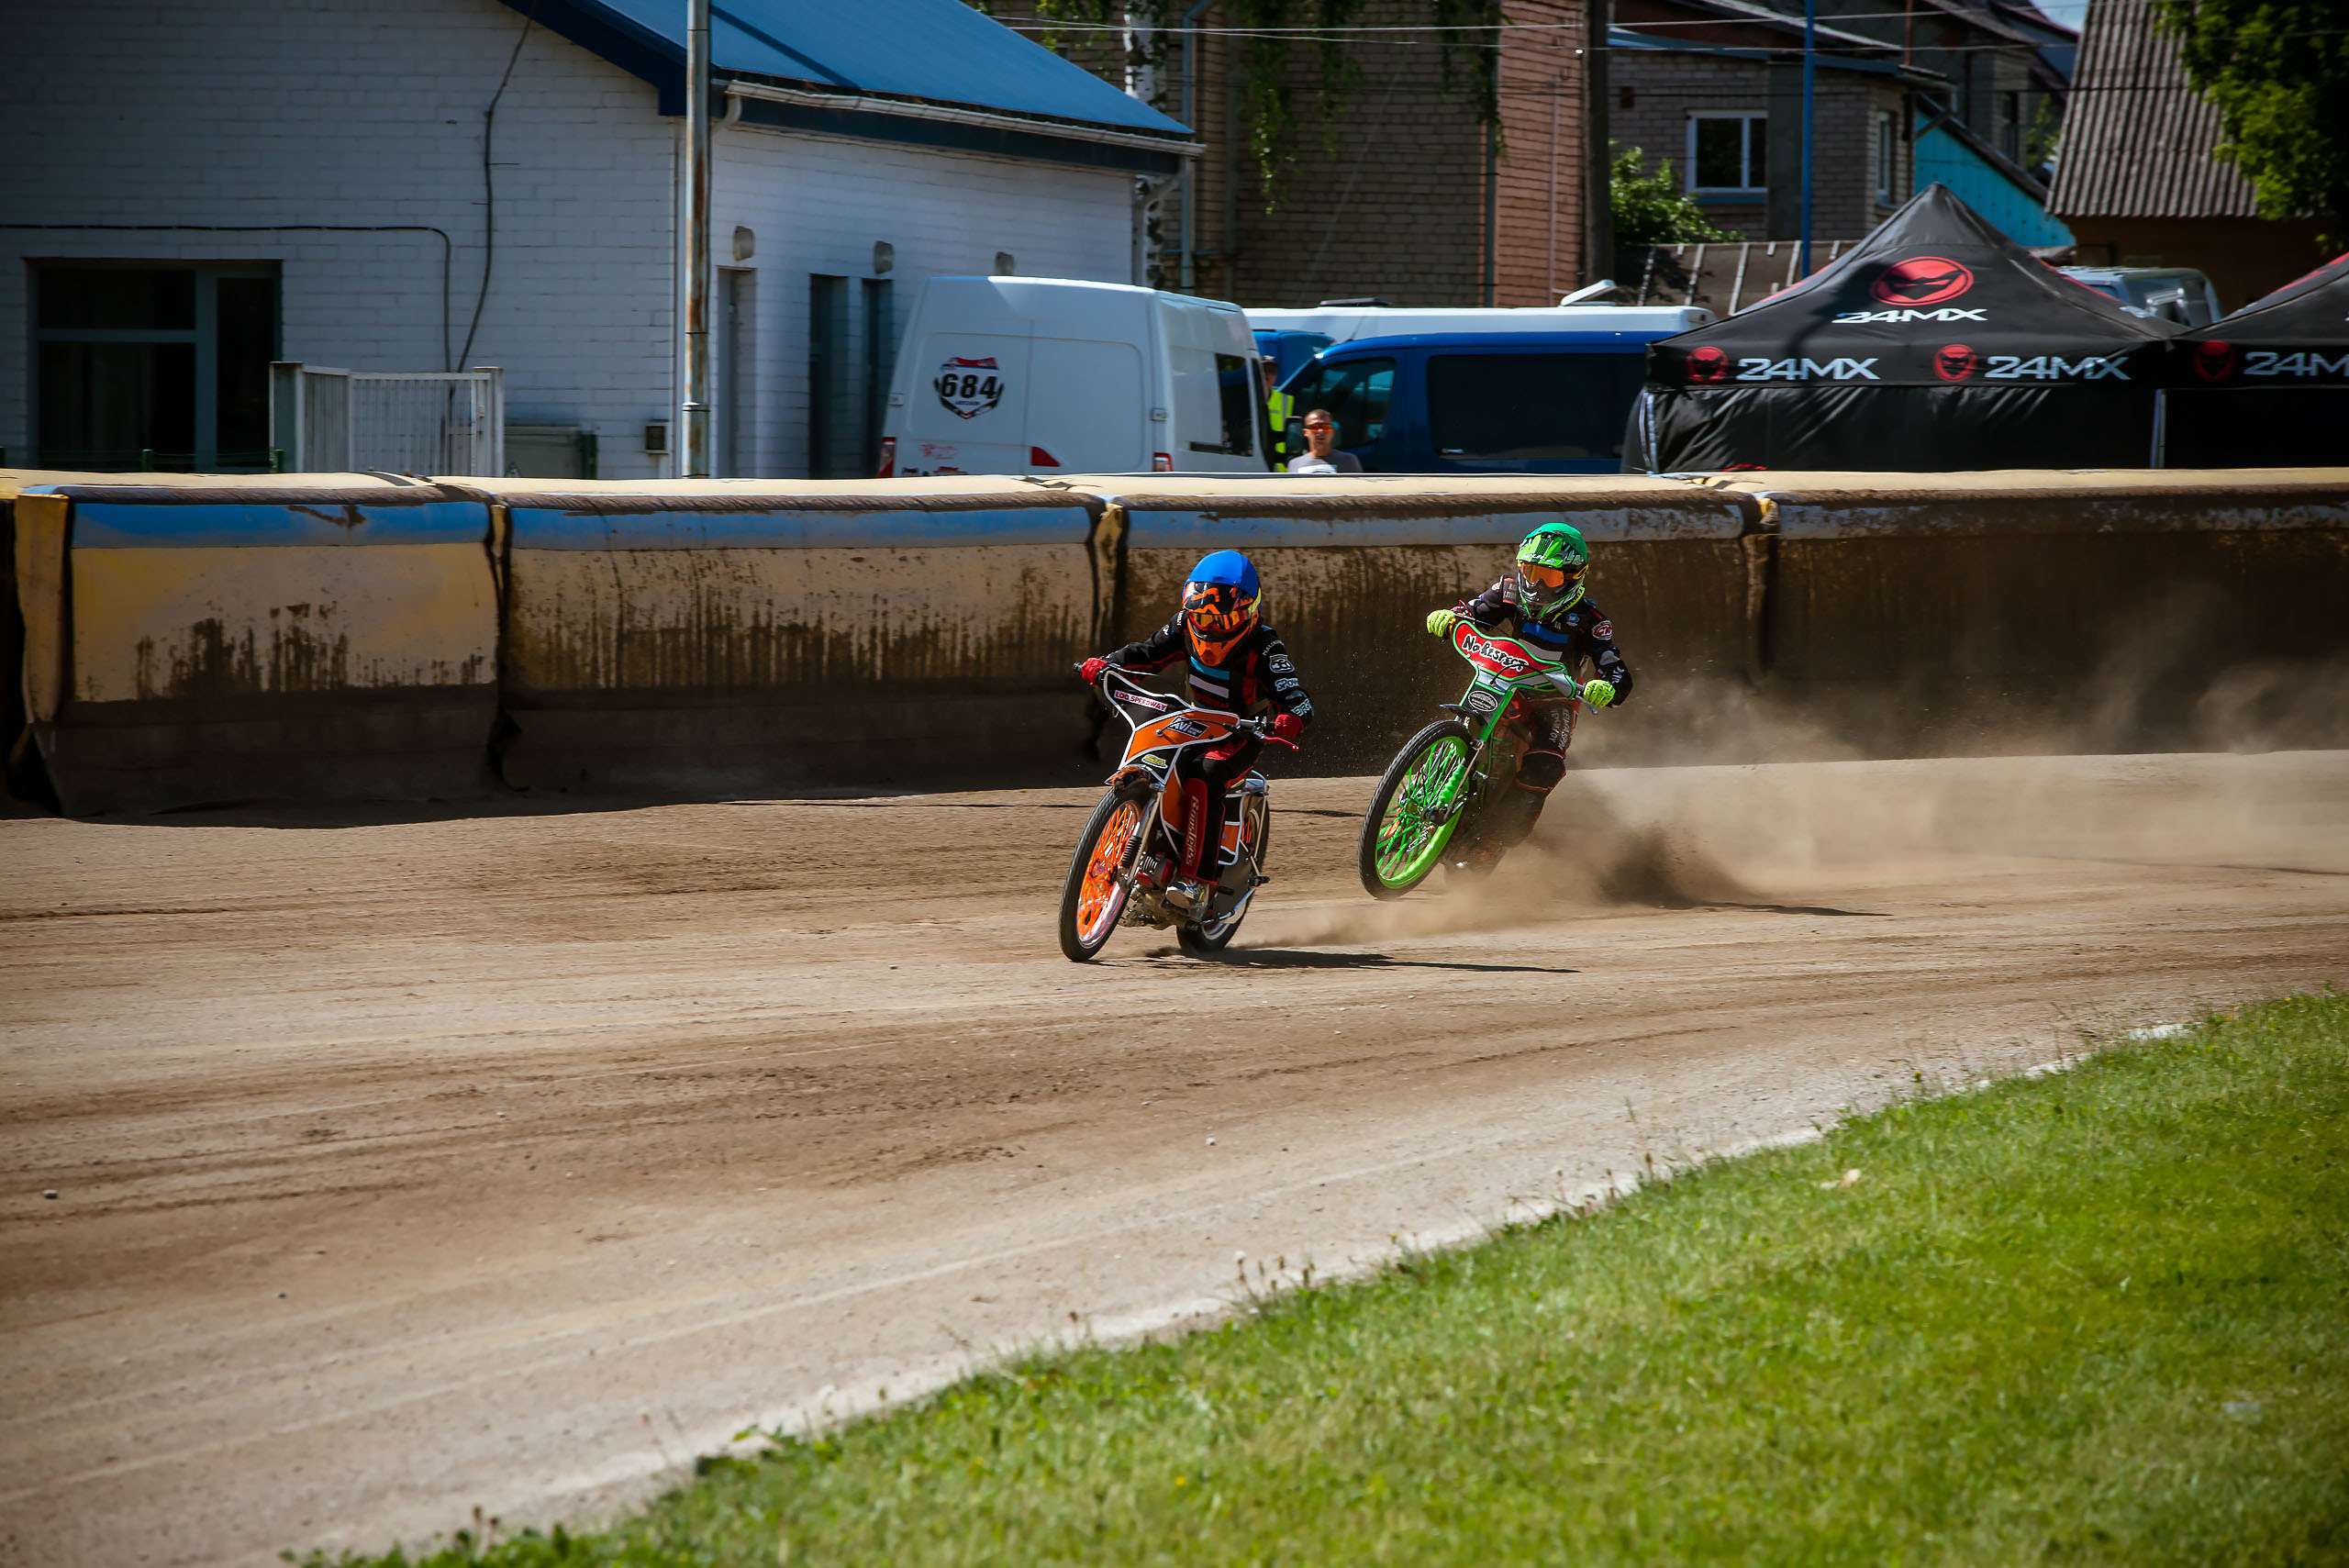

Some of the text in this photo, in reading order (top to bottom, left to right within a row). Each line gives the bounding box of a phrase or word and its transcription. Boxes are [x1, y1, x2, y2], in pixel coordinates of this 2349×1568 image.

[1831, 308, 1988, 323] 24MX
[1736, 358, 1880, 380] 24MX
[1985, 356, 2132, 380] 24MX
[941, 373, 998, 399] 684
[1130, 695, 1168, 713] SPEEDWAY
